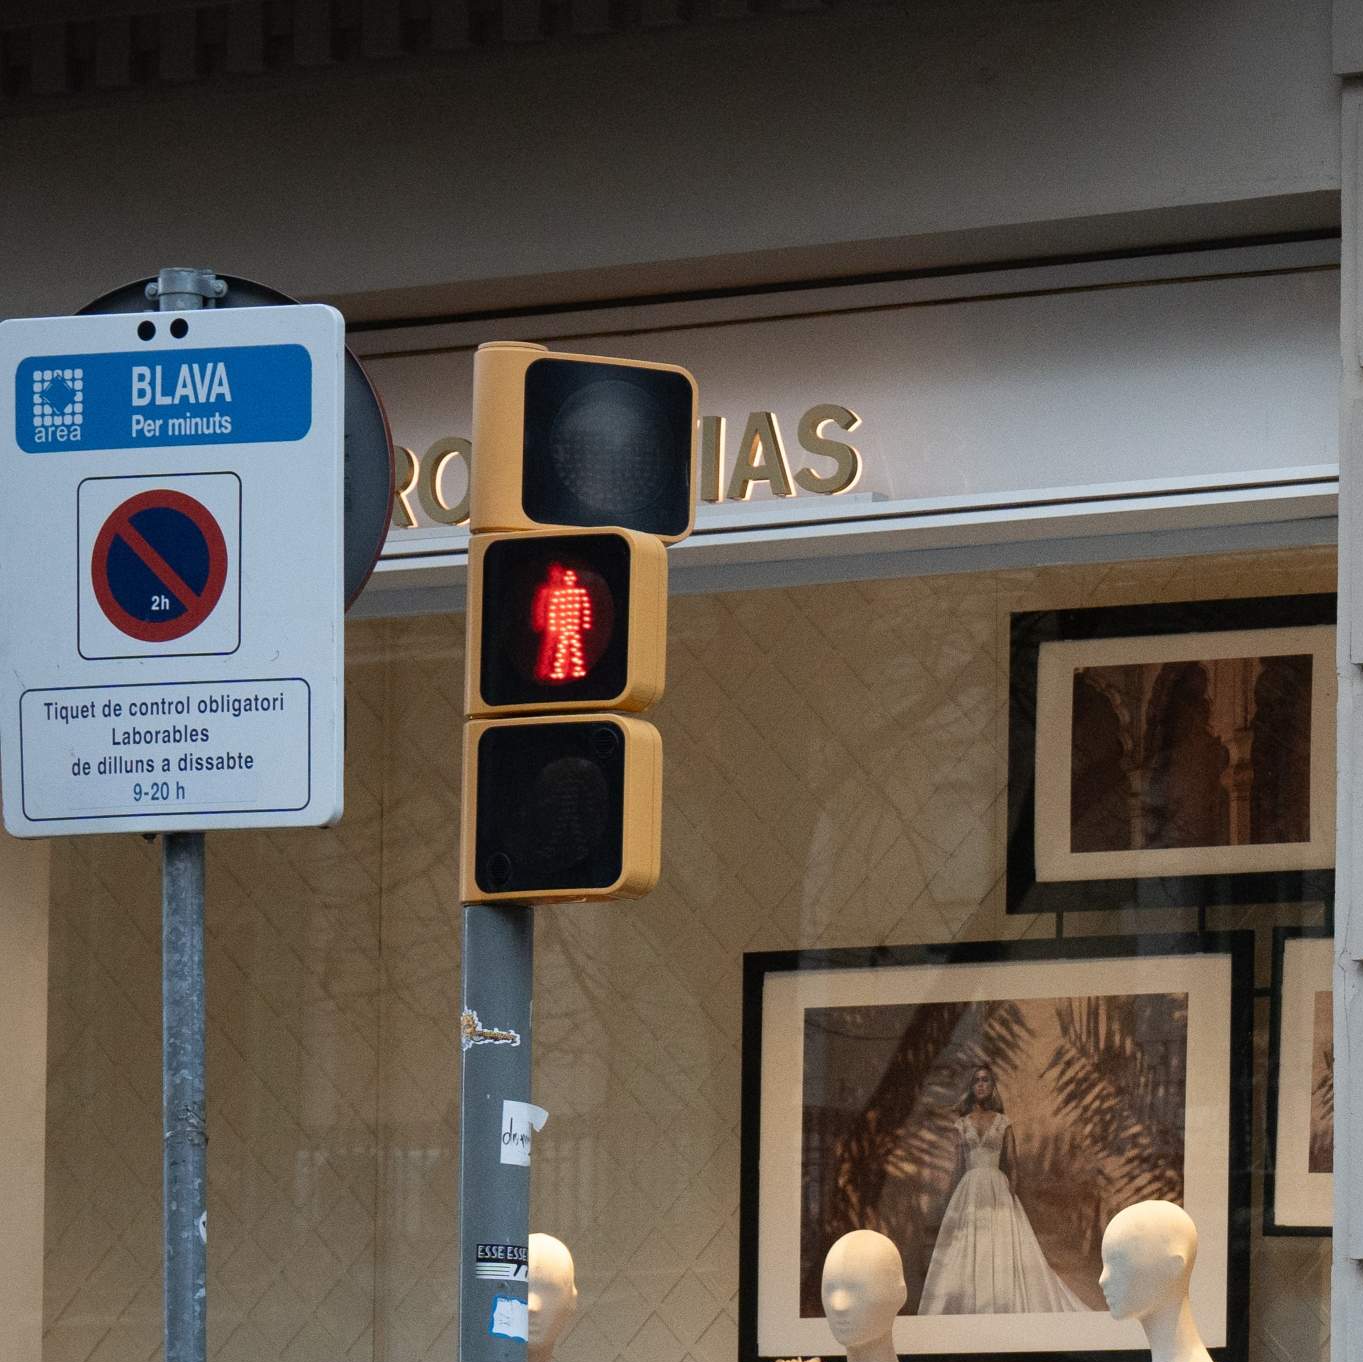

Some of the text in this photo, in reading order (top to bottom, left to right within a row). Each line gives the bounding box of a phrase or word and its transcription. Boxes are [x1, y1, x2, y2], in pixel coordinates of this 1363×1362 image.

[131, 361, 232, 407] BLAVA
[34, 424, 82, 443] area
[131, 411, 232, 438] Per minuts
[151, 595, 170, 611] 2h
[44, 692, 285, 722] Tiquet de control obligatori
[111, 724, 210, 746] Laborables
[71, 750, 254, 777] de dilluns a dissabte
[133, 780, 186, 802] 9-20 h
